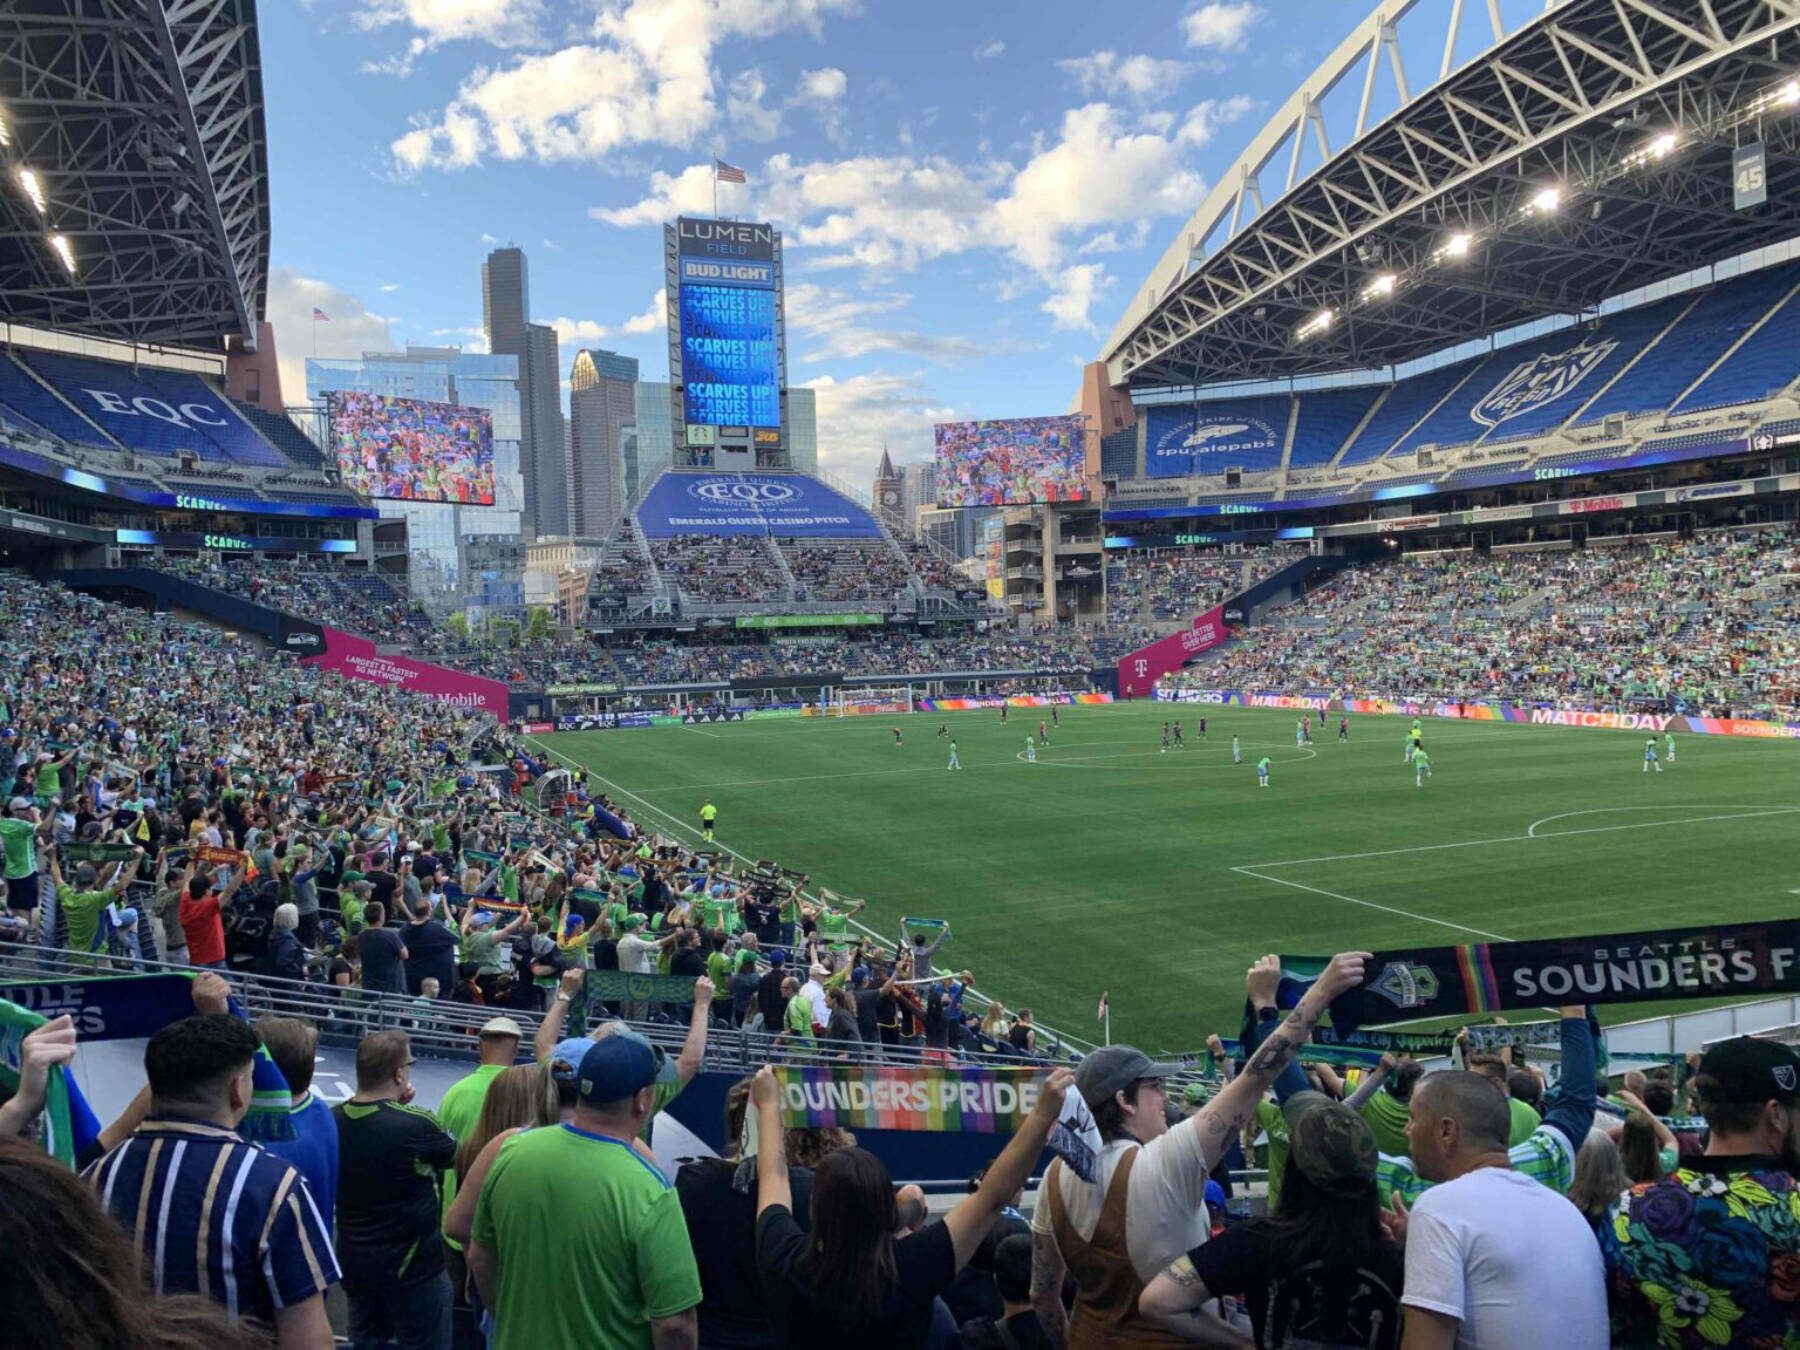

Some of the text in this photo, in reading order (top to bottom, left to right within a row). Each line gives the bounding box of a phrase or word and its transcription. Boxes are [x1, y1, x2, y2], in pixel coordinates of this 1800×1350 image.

[1737, 165, 1762, 192] 45
[680, 223, 771, 243] LUMEN
[706, 243, 747, 255] FIELD
[686, 263, 769, 281] BUD LIGHT
[686, 338, 747, 355] SCARVES
[688, 382, 748, 400] SCARVES
[81, 388, 229, 431] EQC
[697, 484, 794, 502] EQC
[1583, 497, 1623, 512] Mobile
[669, 516, 850, 526] EMERALD QUEEN CASINO PITCH
[1192, 623, 1214, 637] BETTER
[1183, 637, 1200, 650] OVER
[1199, 631, 1216, 644] HERE
[345, 655, 379, 669] LARGEST
[387, 664, 419, 681] FASTEST
[356, 665, 405, 683] 5G NETWORK
[438, 691, 486, 707] Mobile
[1156, 688, 1223, 703] SONDERS
[1250, 695, 1331, 711] MATCHDAY
[558, 722, 576, 731] EQC
[598, 719, 615, 729] EQC
[1532, 709, 1674, 731] MATCHDAY
[1594, 938, 1736, 960] SEATTLE
[1513, 950, 1757, 997] SOUNDERS
[940, 1082, 1039, 1114] PRIDE
